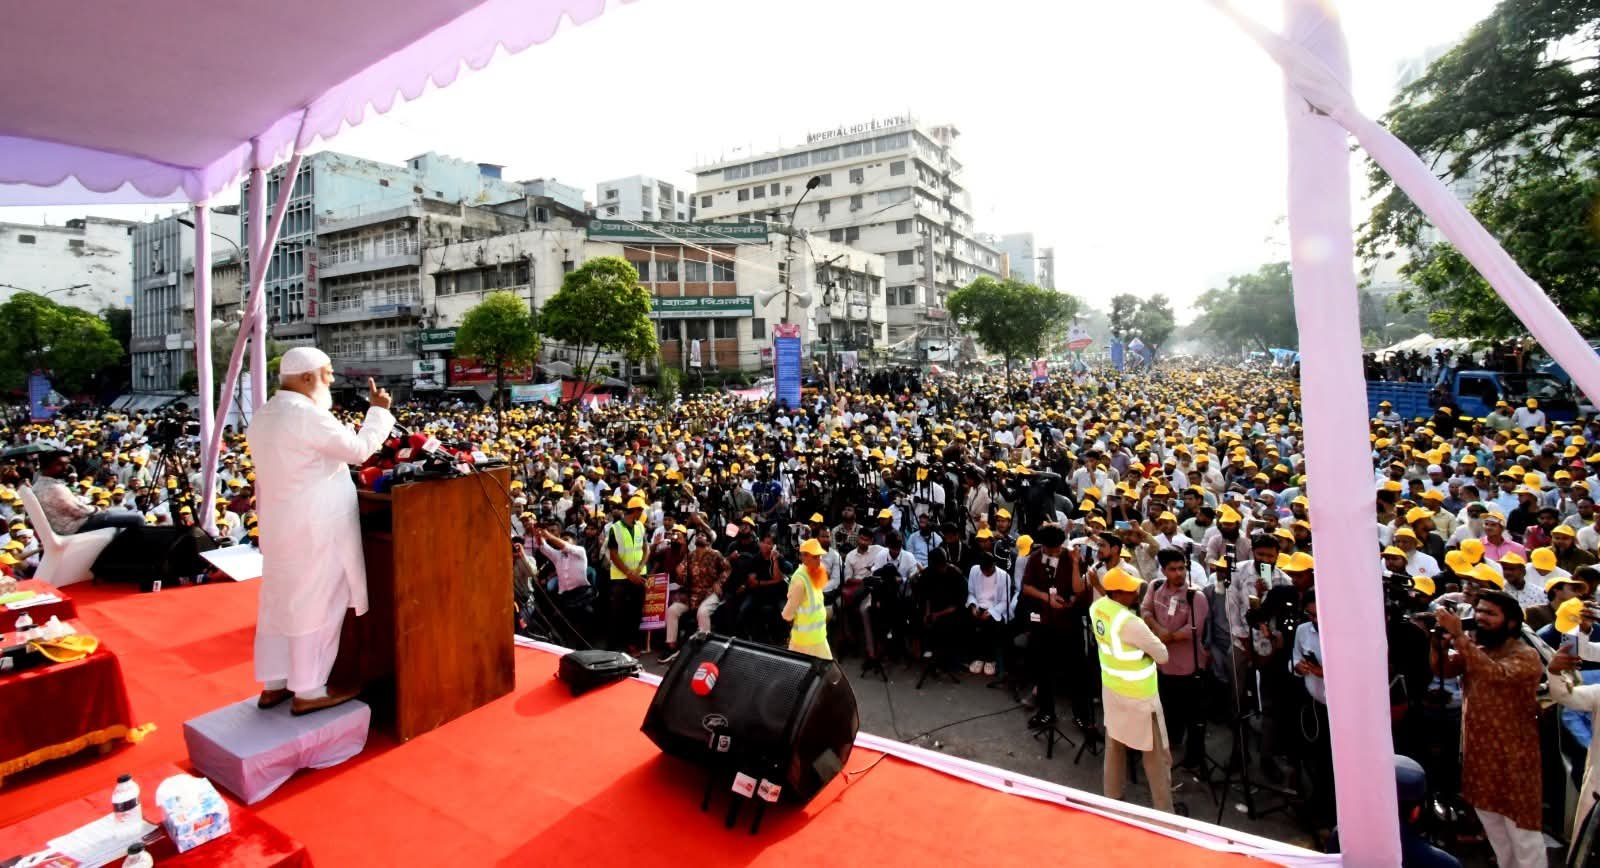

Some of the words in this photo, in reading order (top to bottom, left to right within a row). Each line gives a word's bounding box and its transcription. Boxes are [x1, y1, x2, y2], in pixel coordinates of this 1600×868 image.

[807, 128, 848, 142] IMPERIAL
[850, 119, 881, 134] HOTEL
[700, 297, 752, 306] পিএলসি
